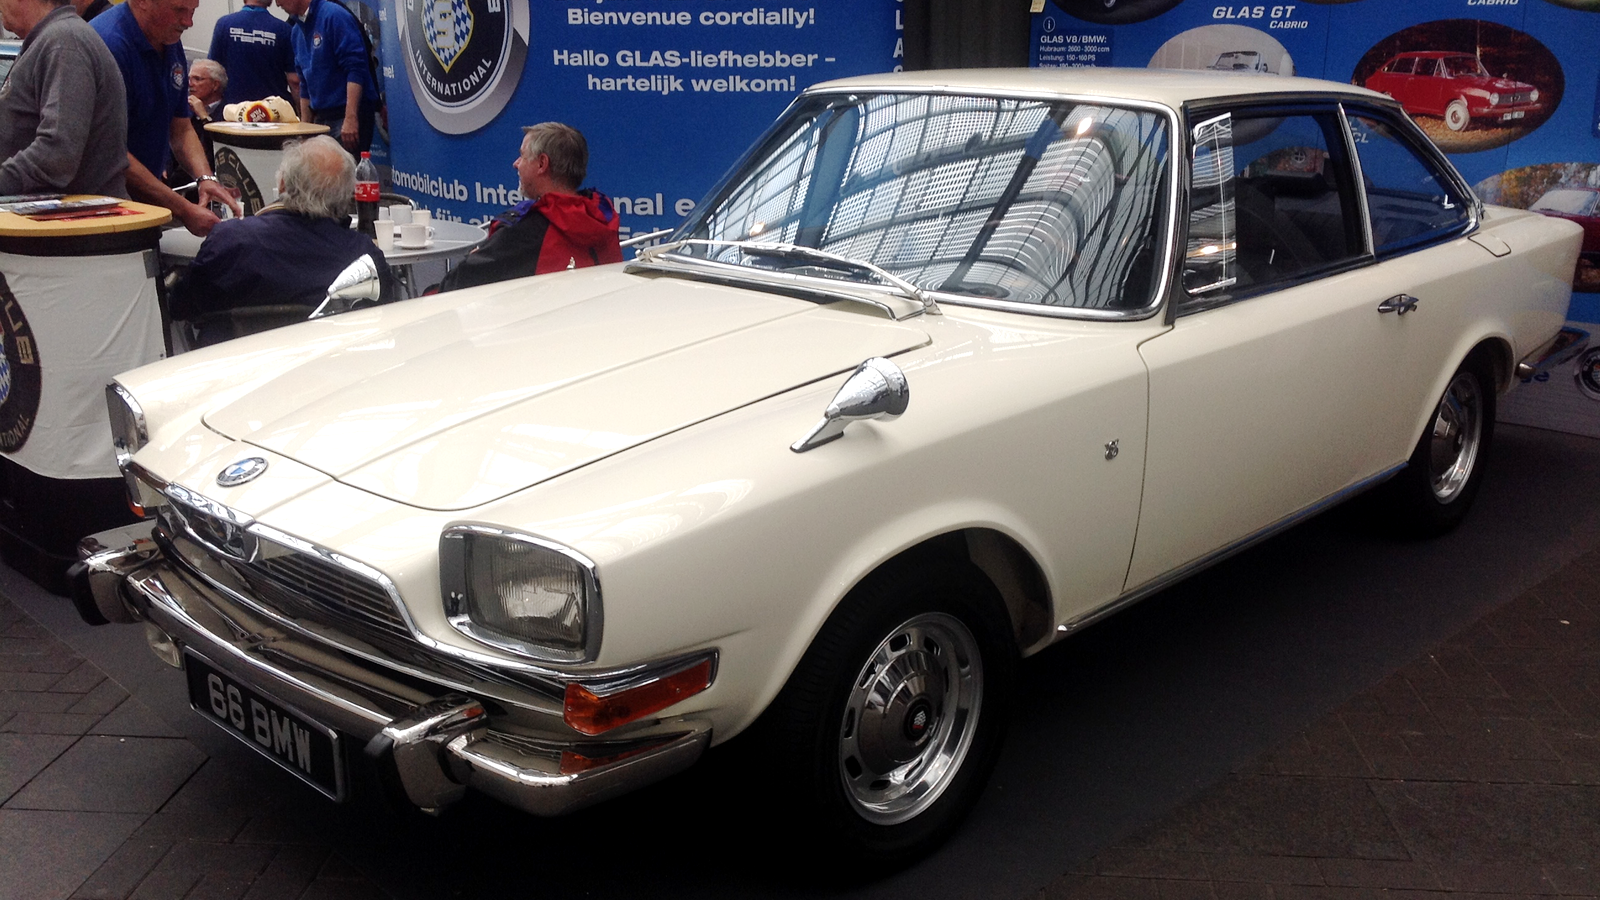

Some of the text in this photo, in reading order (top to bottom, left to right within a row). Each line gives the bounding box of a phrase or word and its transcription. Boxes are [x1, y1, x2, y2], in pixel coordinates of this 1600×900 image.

[567, 7, 815, 29] Bienvenue cordially!
[1212, 5, 1296, 19] GLAS GT
[1269, 20, 1309, 29] CABRIO
[893, 0, 904, 72] LA
[1040, 35, 1064, 44] GLAS
[553, 50, 609, 66] Hallo
[616, 50, 818, 68] GLAS-liefhebber
[416, 49, 492, 96] INTERNATIONAL
[587, 74, 796, 96] hartelijk welkom!
[207, 672, 311, 774] 66 BMW
